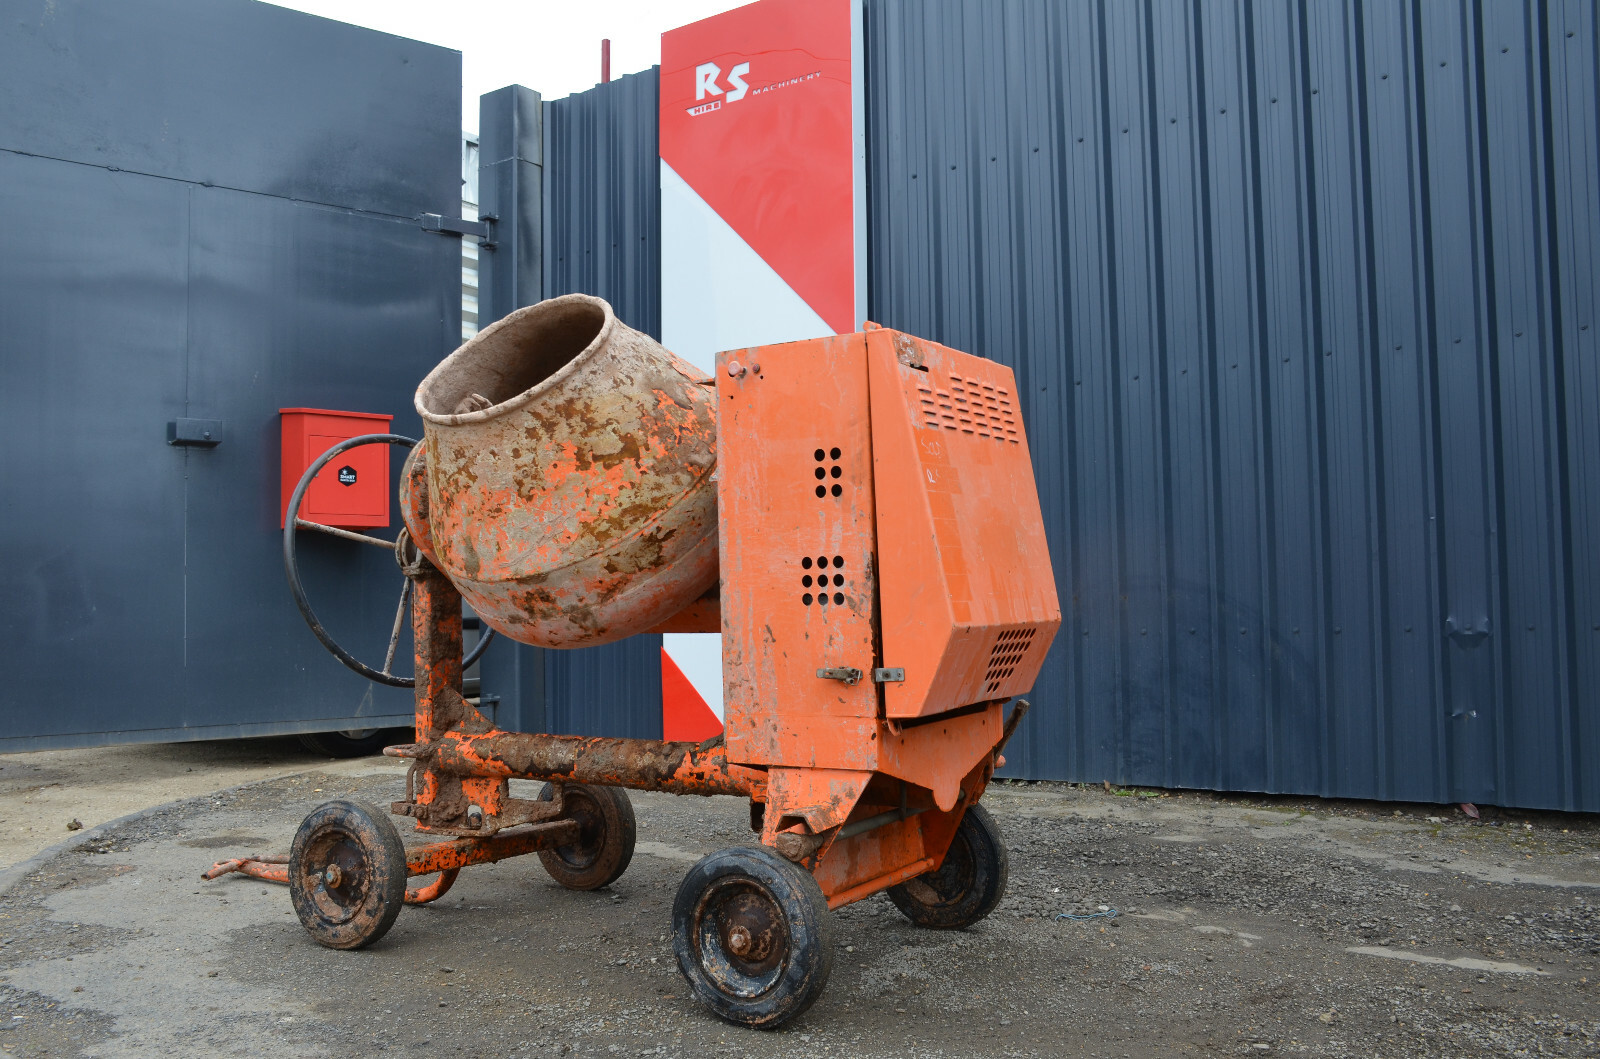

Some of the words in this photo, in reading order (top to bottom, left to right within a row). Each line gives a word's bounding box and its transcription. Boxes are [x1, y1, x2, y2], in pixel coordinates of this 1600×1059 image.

[695, 61, 750, 103] RS
[752, 70, 822, 96] MACHINERY
[693, 102, 721, 115] HIRE
